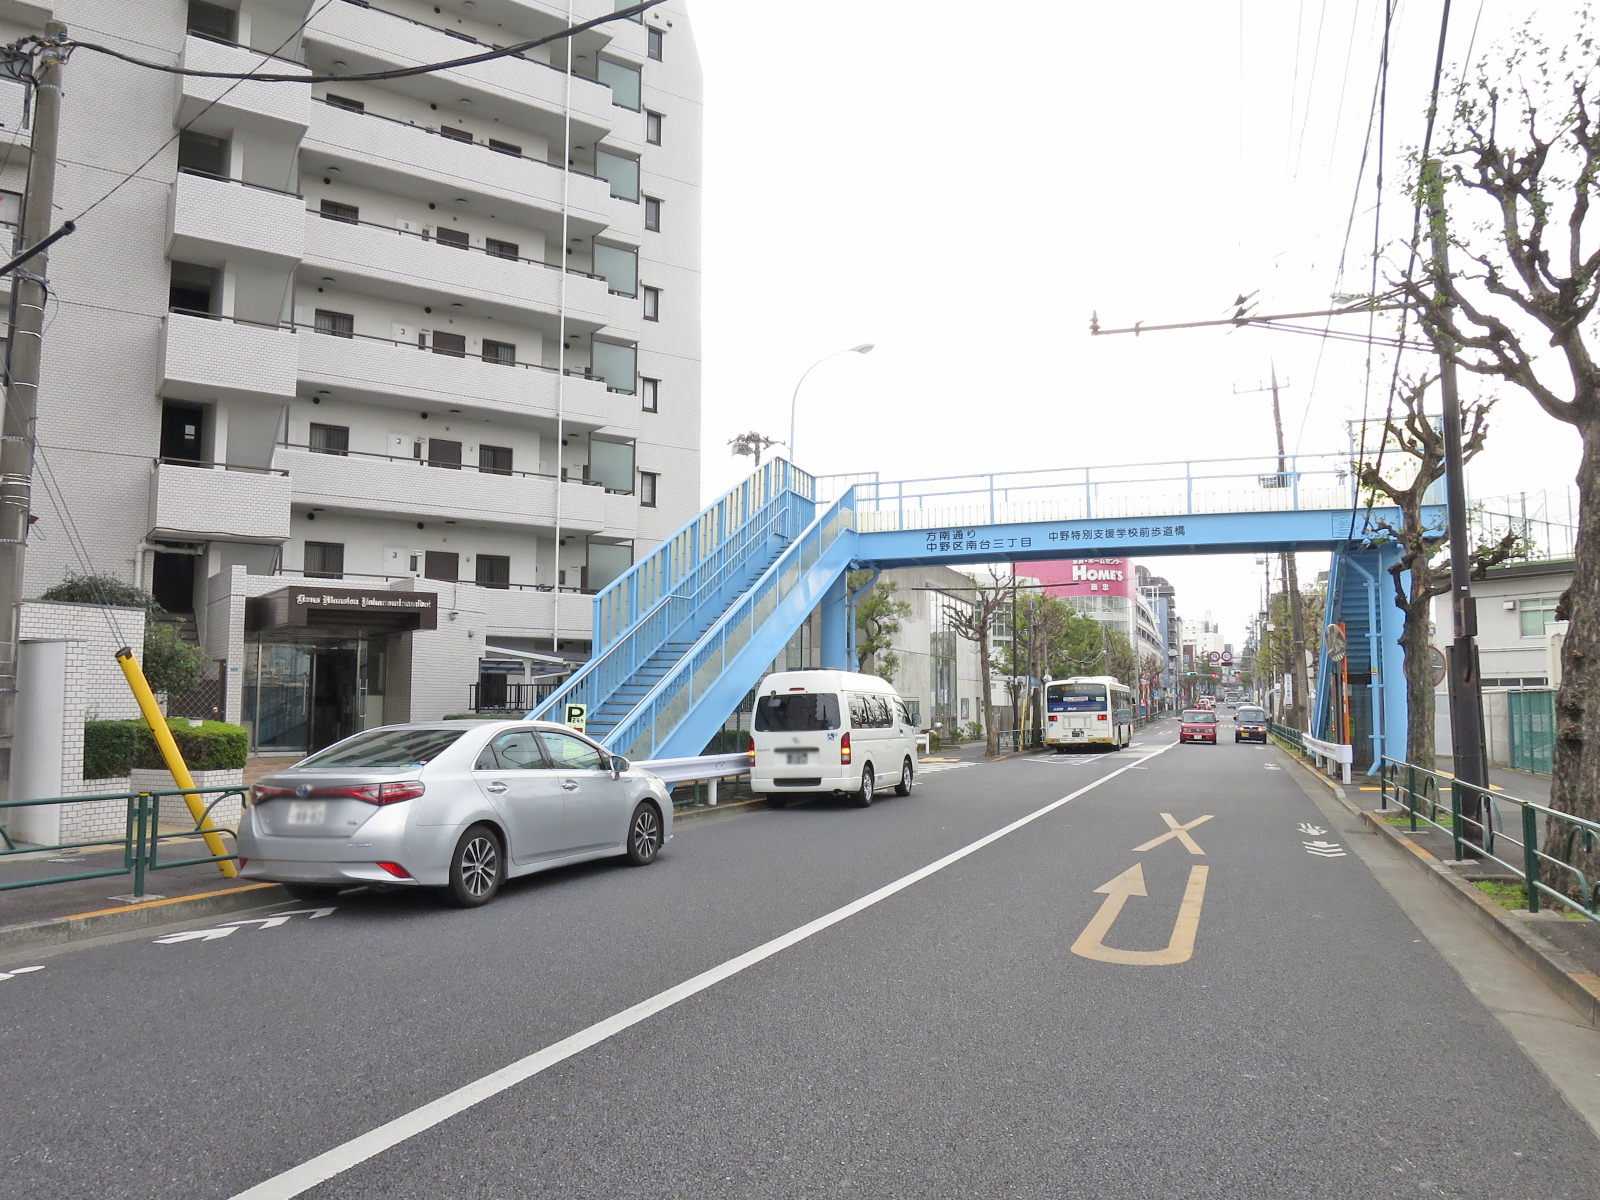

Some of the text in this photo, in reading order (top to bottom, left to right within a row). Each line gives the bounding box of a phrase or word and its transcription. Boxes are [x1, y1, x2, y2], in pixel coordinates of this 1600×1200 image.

[926, 529, 976, 541] 方南通り
[1048, 525, 1186, 541] 中野特別支援学校前歩道橋
[926, 537, 1032, 552] 中野区南台三丁目
[567, 706, 584, 722] P
